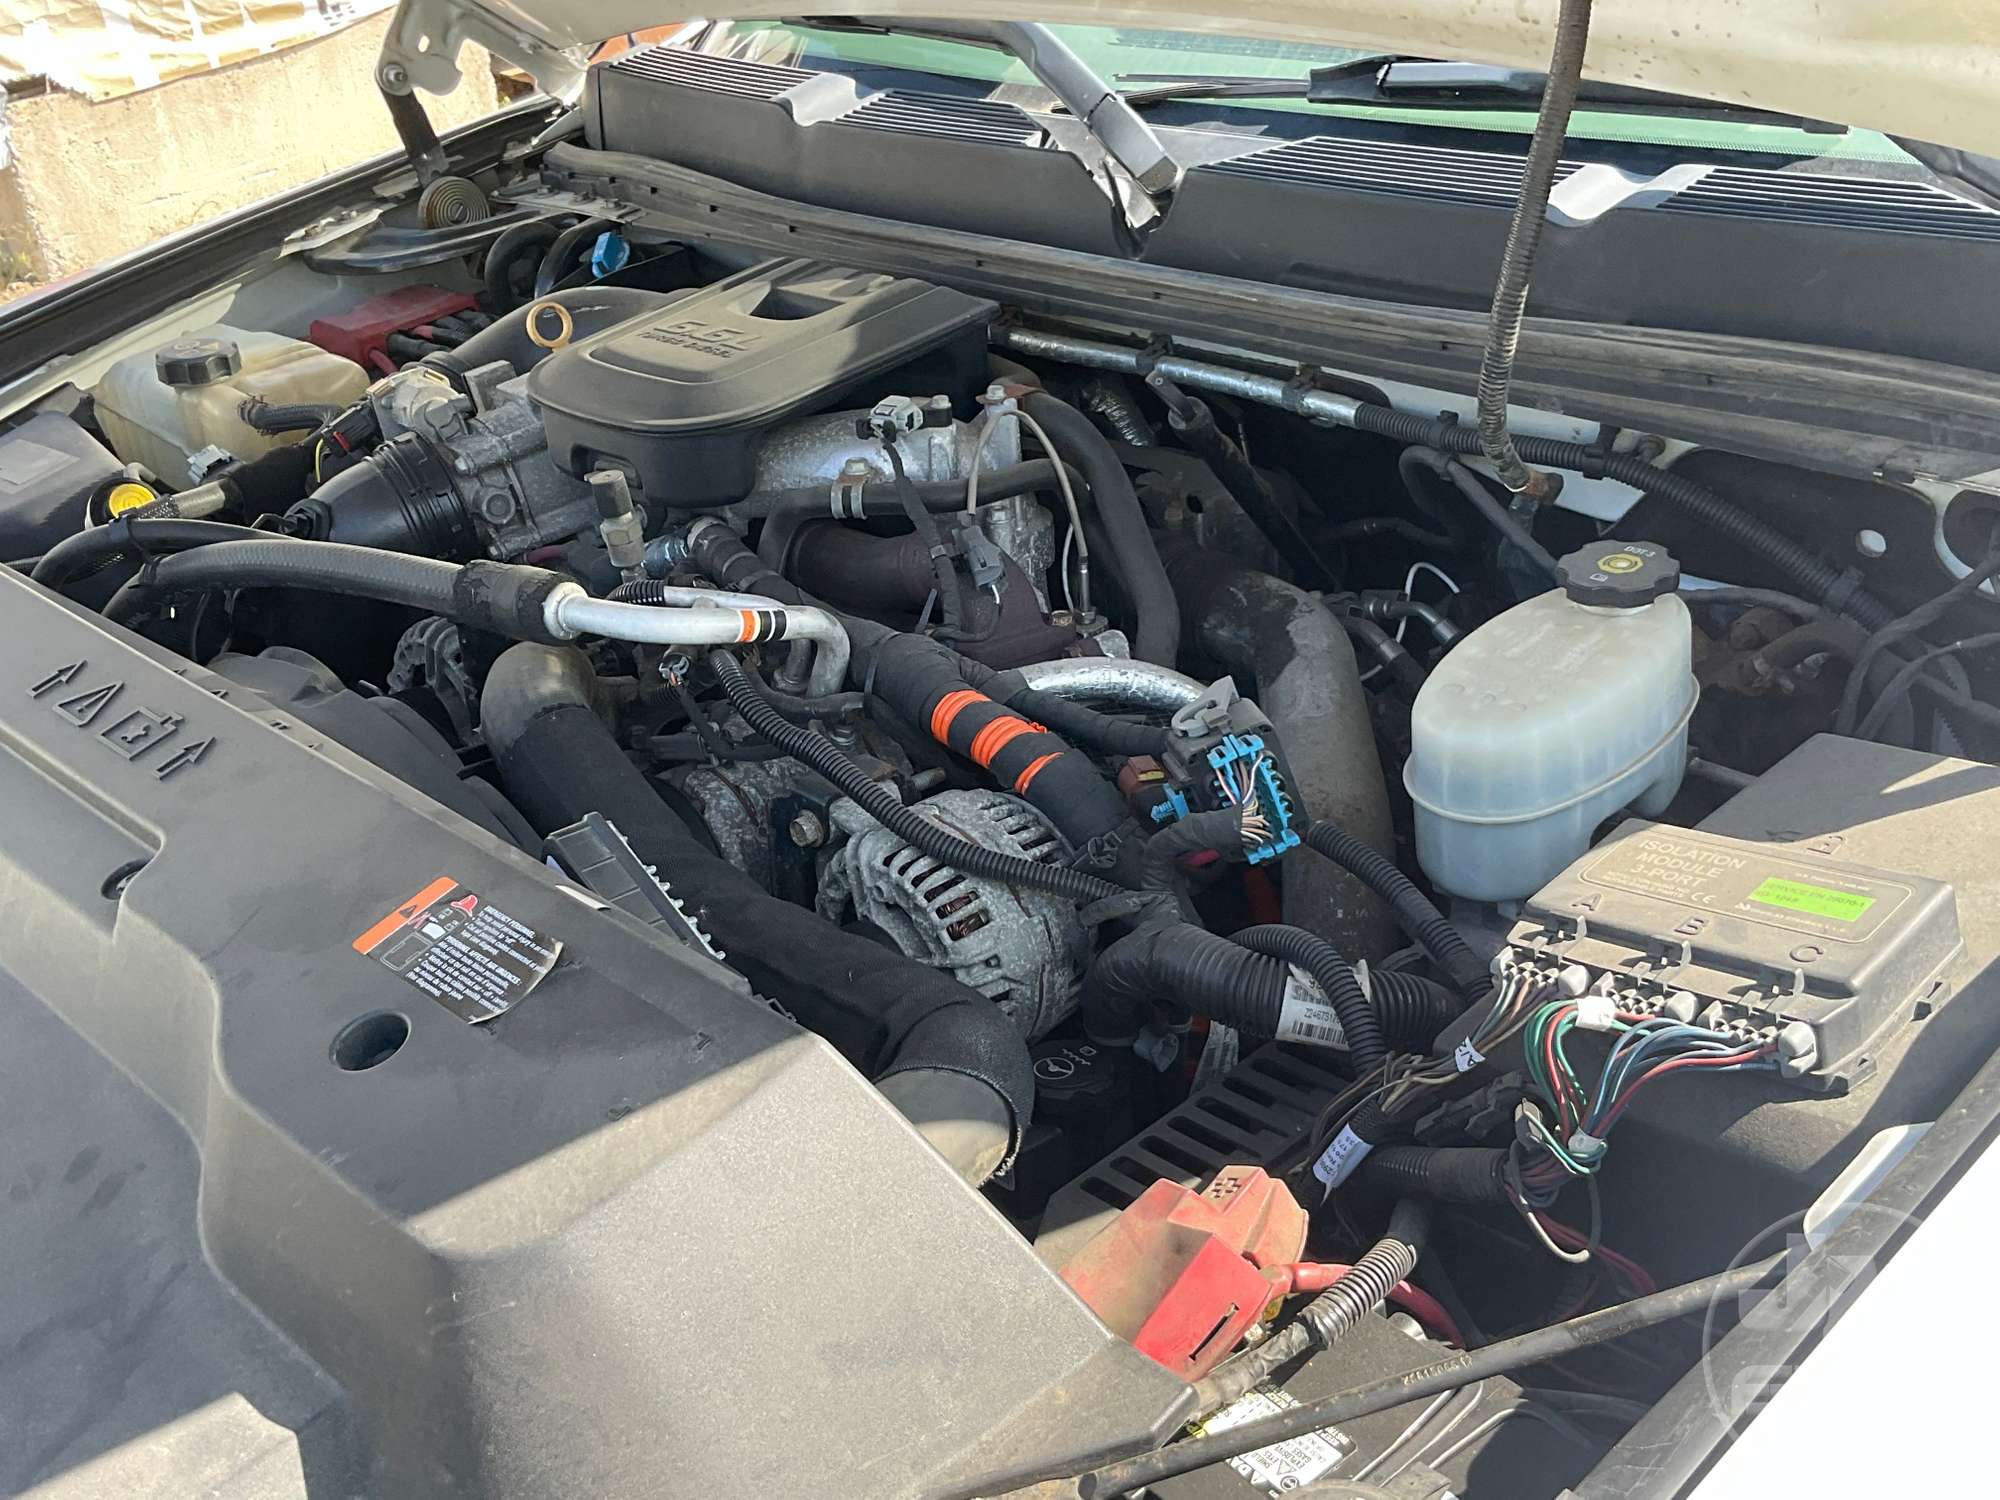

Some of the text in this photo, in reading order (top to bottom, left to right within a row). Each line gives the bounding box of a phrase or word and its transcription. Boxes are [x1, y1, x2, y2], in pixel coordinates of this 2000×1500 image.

[1640, 840, 1747, 869] ISOLATION
[1636, 852, 1723, 878] MODULE
[1630, 865, 1707, 888] 3-PORT
[1571, 893, 1602, 912] A
[1673, 916, 1707, 936] B
[1789, 944, 1825, 964] C
[1249, 1450, 1272, 1470] SHIELD
[1261, 1448, 1279, 1464] EYES
[1291, 1446, 1312, 1464] GASES
